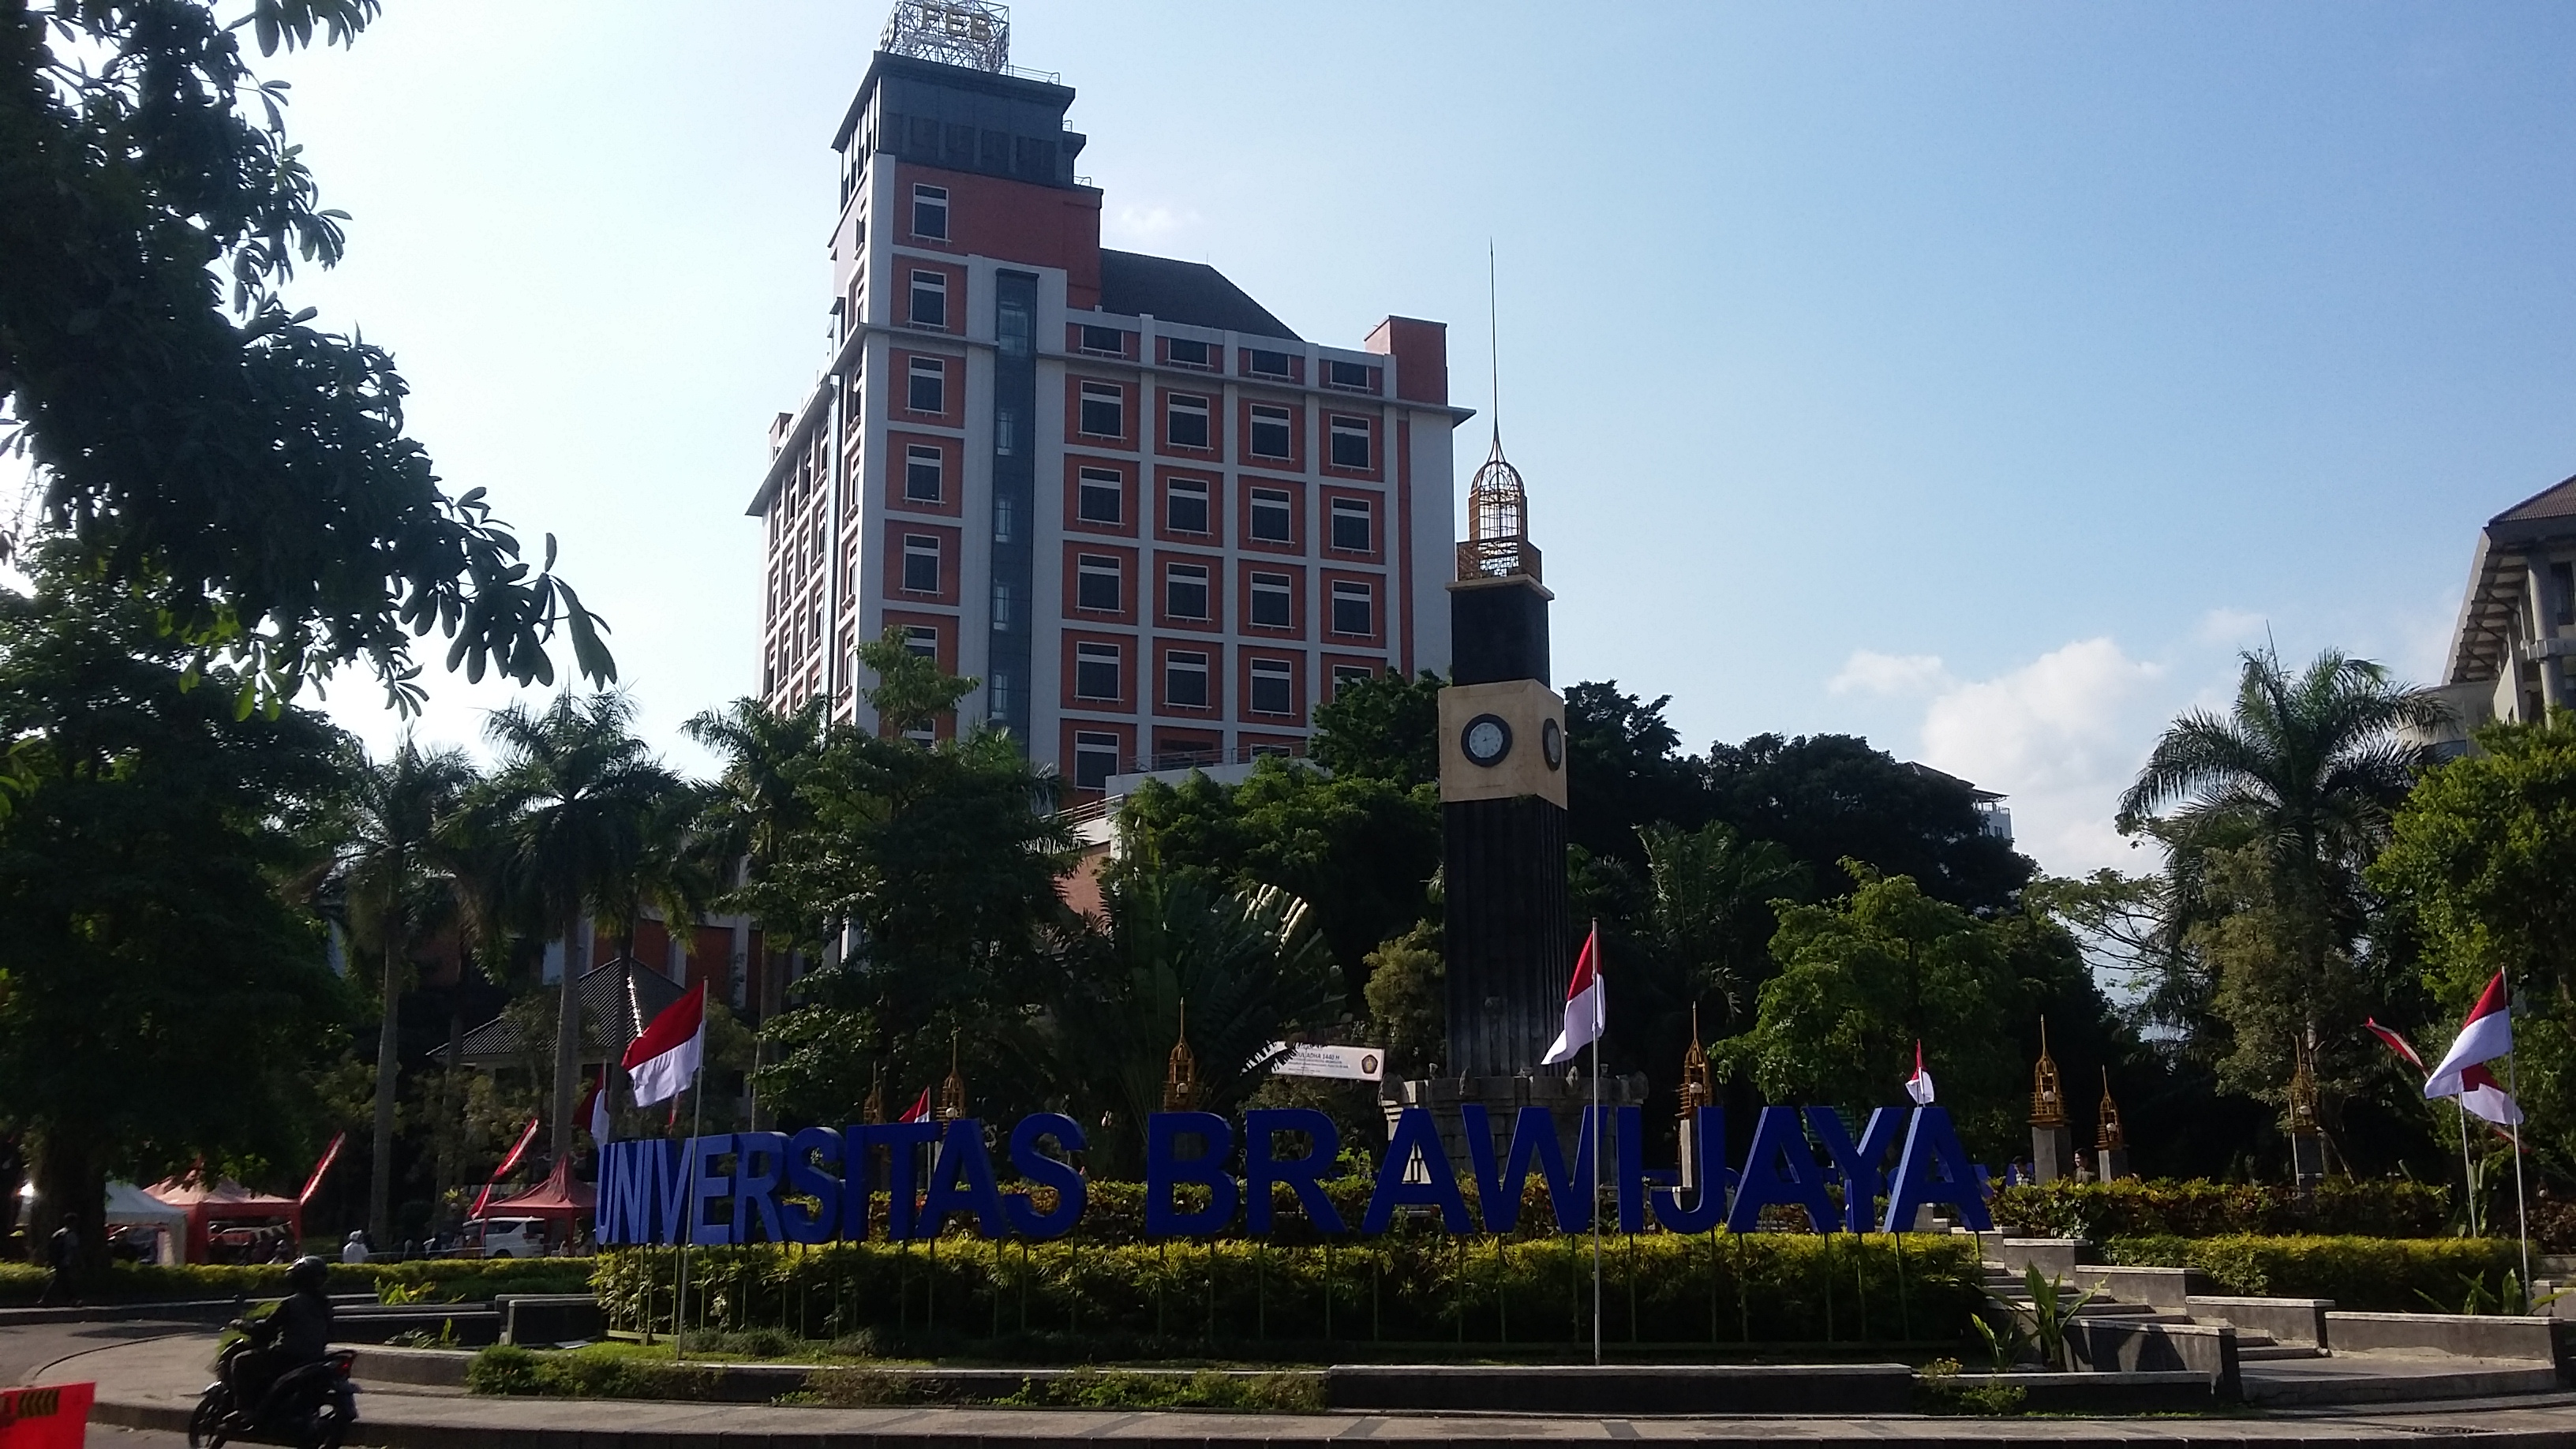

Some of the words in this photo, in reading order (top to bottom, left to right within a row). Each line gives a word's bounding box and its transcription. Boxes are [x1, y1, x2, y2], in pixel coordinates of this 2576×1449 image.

[922, 1, 991, 42] FEB
[596, 1113, 1088, 1245] UNIVERSITAS
[1146, 1104, 1995, 1236] BRAWIJAYA
